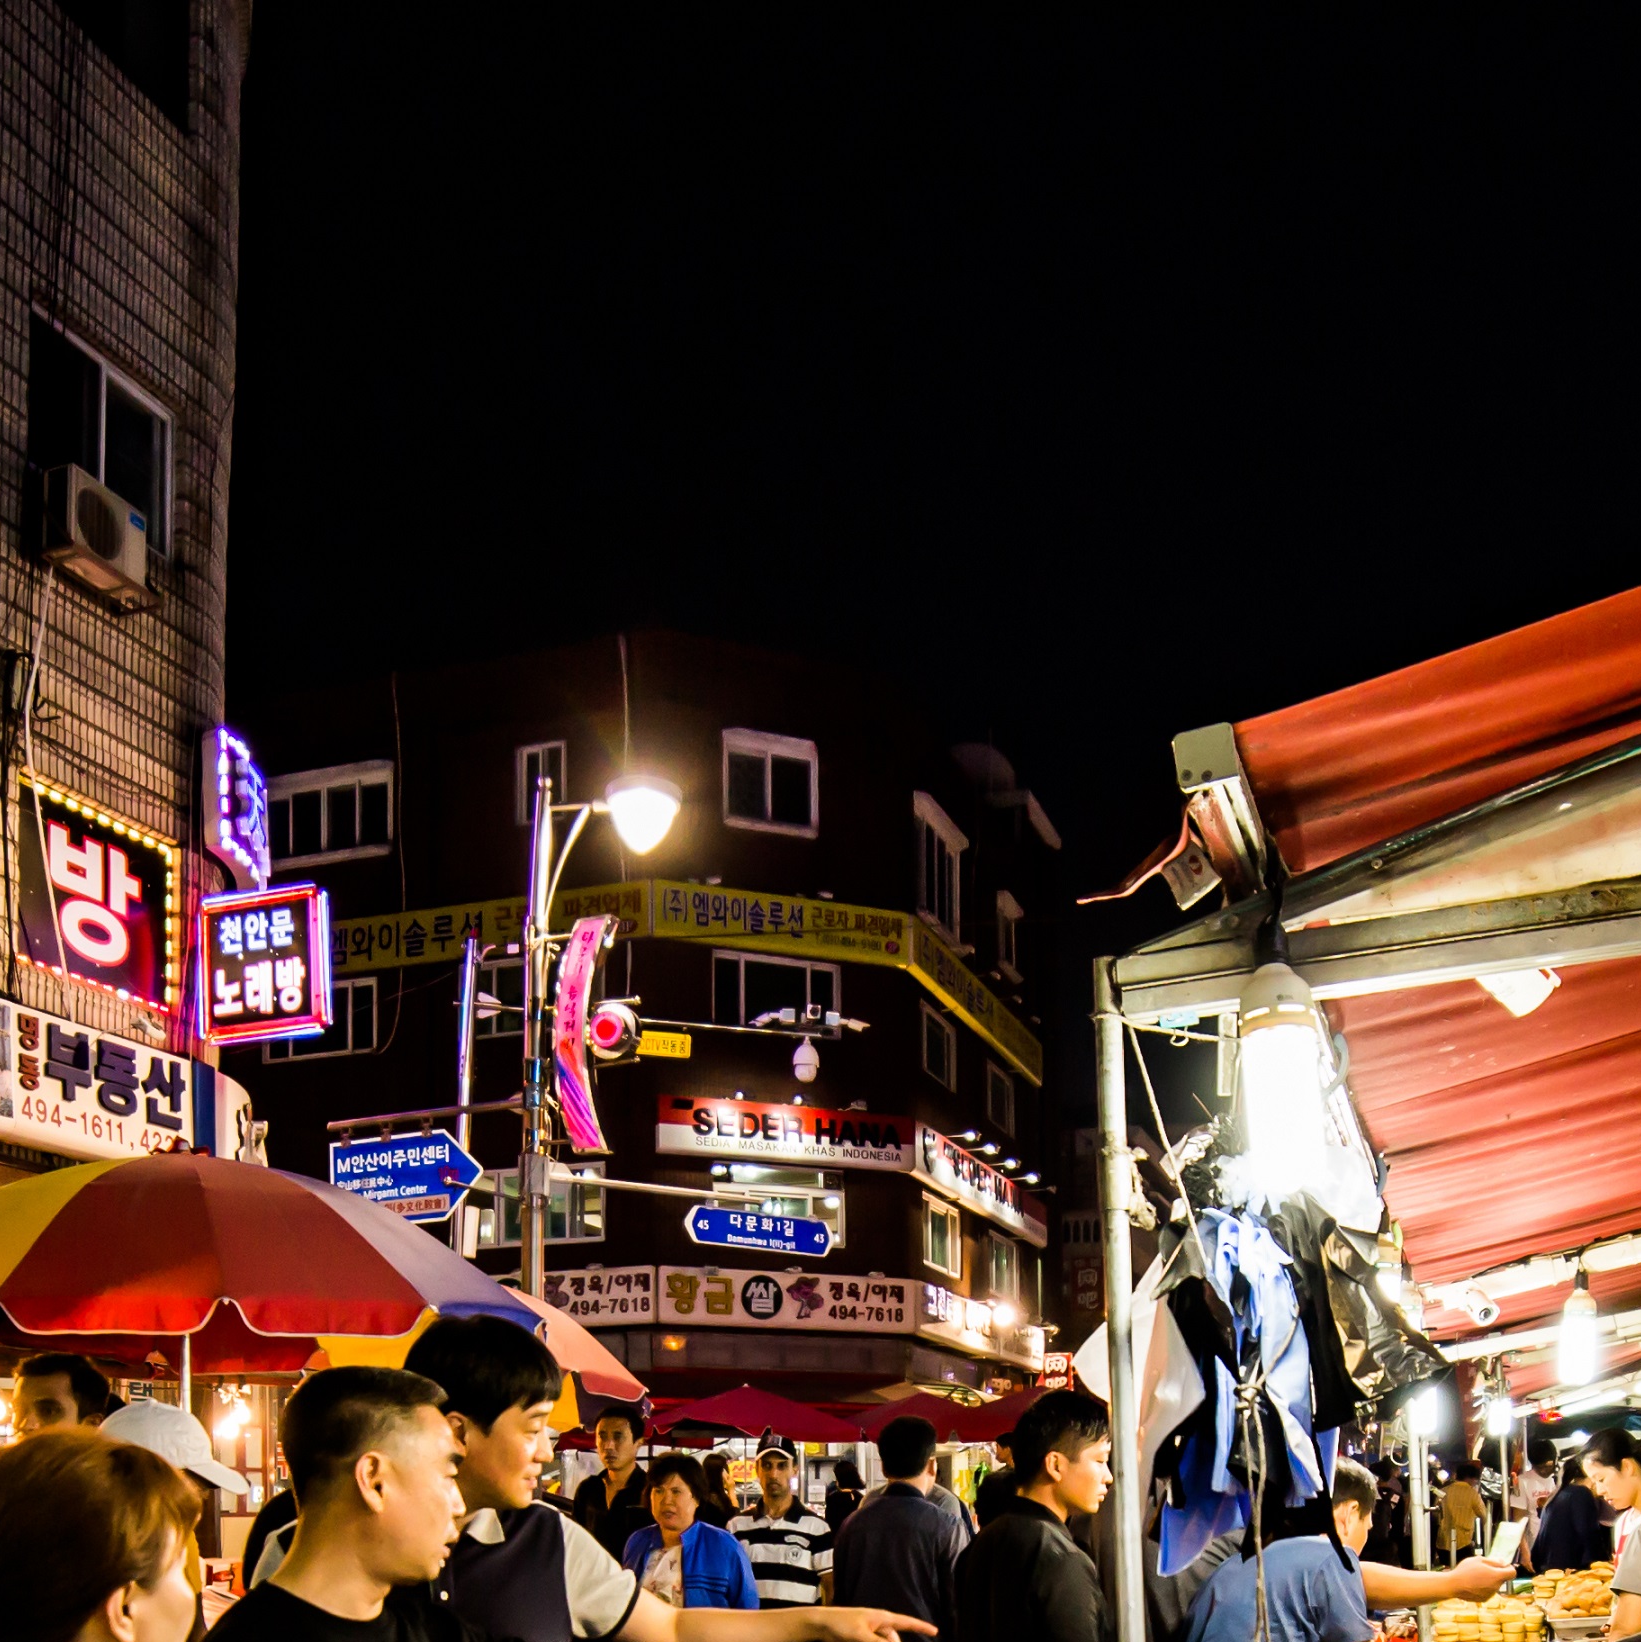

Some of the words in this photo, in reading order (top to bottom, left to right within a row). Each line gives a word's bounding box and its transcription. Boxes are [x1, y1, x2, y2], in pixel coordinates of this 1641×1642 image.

[47, 818, 142, 968] 방
[220, 908, 295, 954] 천안문
[213, 956, 307, 1018] 노래방
[18, 1013, 41, 1091] 명동
[45, 1022, 187, 1132] 부동산
[692, 1107, 803, 1143] SEDER
[815, 1117, 902, 1150] HANA
[695, 1136, 731, 1149] SEDIA
[738, 1140, 798, 1154] MASAKAN
[804, 1145, 836, 1158] KHAS
[842, 1148, 902, 1162] INDONESIA
[400, 1184, 428, 1197] Center
[697, 1219, 710, 1230] 45
[813, 1233, 825, 1244] 43
[569, 1297, 651, 1316] 494-7618
[828, 1305, 905, 1323] 494-7618
